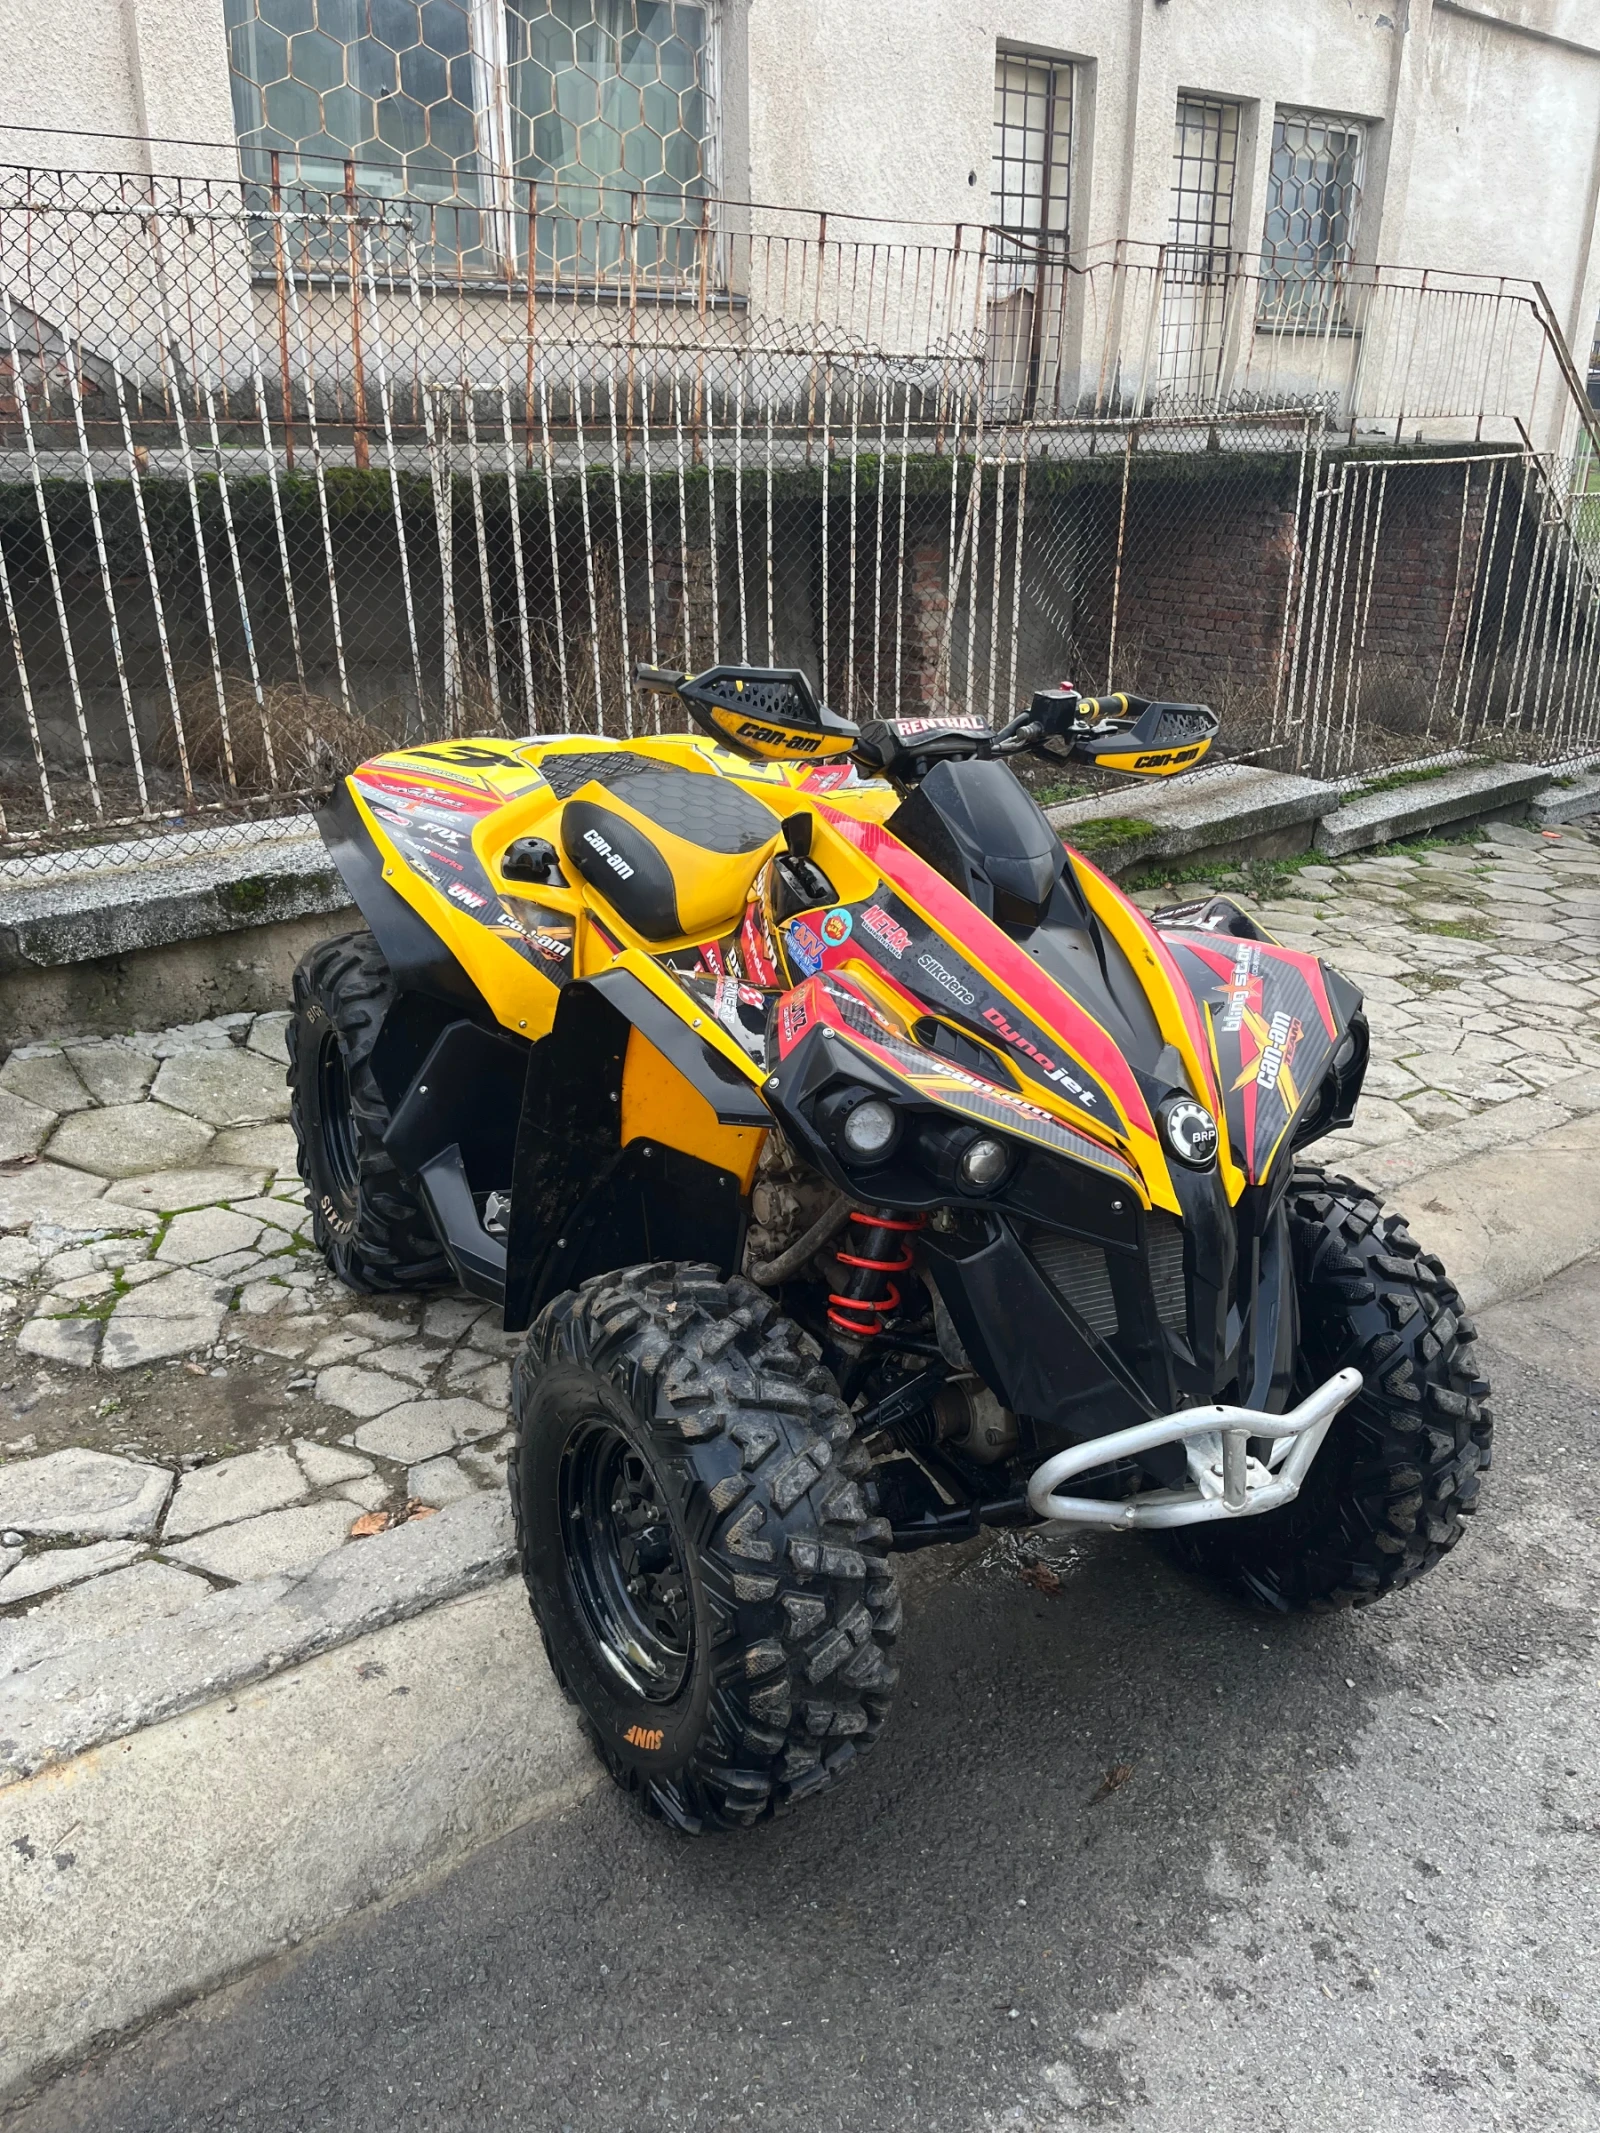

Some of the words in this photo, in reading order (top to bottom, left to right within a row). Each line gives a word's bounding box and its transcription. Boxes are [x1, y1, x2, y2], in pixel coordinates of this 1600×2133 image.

[736, 722, 822, 753] can-am
[897, 717, 984, 736] RENTHAL
[1133, 747, 1200, 769] can-am
[404, 839, 465, 871] motoworks
[583, 828, 635, 880] can-am
[795, 922, 828, 959] ATV
[918, 953, 974, 1005] Silkolene
[1234, 943, 1254, 986] star
[1221, 989, 1250, 1032] bling
[982, 1007, 1097, 1107] Dynojet
[1256, 1011, 1292, 1090] can-am
[1284, 1019, 1302, 1066] TEAM
[932, 1063, 1053, 1120] can-am
[1192, 1130, 1215, 1143] BRP
[622, 1724, 664, 1750] SUNF
